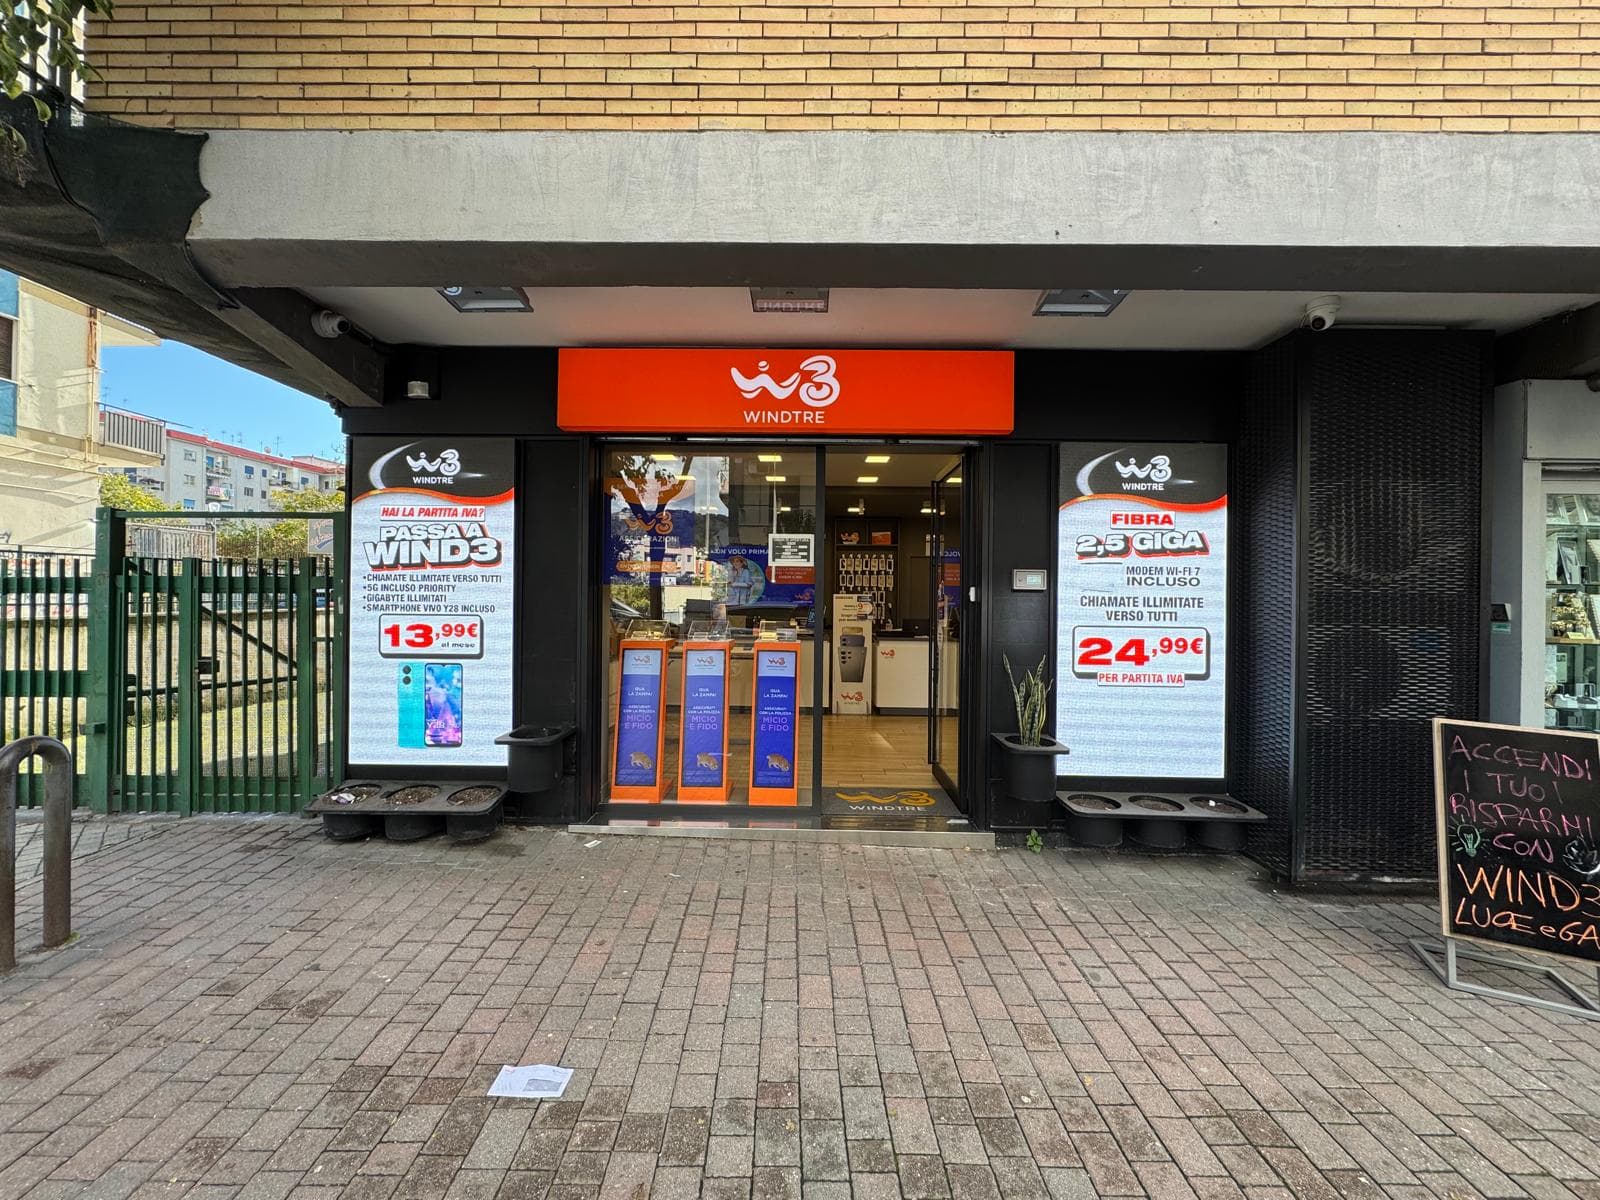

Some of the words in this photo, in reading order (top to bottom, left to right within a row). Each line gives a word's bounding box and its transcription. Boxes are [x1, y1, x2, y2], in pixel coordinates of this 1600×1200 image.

[743, 411, 825, 424] WINDTRE
[412, 476, 454, 485] WINDTRE
[1121, 483, 1165, 491] WINDTRE
[381, 507, 399, 517] HAI
[402, 507, 415, 517] LA
[418, 508, 458, 518] PARTITA
[461, 508, 485, 518] IVA?
[1111, 513, 1174, 526] FIBRA
[380, 523, 462, 541] PASSA
[464, 522, 487, 538] A
[1076, 534, 1128, 558] 2,5
[1132, 530, 1208, 557] GIGA
[363, 537, 502, 570] WIND3
[1126, 566, 1164, 575] MODEM
[1166, 567, 1192, 575] WI-FI
[1194, 567, 1201, 576] 7
[366, 574, 406, 582] CHIAMATE
[409, 574, 451, 582] ILLIMITATE
[453, 575, 479, 583] VERSO
[481, 575, 502, 583] TUTTI
[1126, 577, 1201, 587] INCLUSO
[367, 584, 379, 592] 5G
[381, 584, 416, 592] INCLUSO
[418, 584, 457, 592] PRIORITY
[366, 594, 405, 602] GIGABYTE
[407, 594, 447, 602] ILLIMITATI
[1080, 595, 1139, 608] CHIAMATE
[1142, 596, 1204, 609] ILLIMITATE
[366, 604, 421, 612] SMARTPHONE
[423, 604, 442, 612] VIVO
[443, 605, 459, 613] Y28
[461, 605, 496, 613] INCLUSO
[1106, 611, 1144, 621] VERSO
[1147, 611, 1178, 622] TUTTI
[384, 623, 478, 648] 13,99€
[1078, 637, 1204, 667] 24,99€
[1098, 673, 1118, 683] PER
[1121, 673, 1164, 683] PARTITA
[1166, 674, 1184, 683] IVA
[626, 714, 651, 722] MICIO
[1450, 735, 1592, 781] ACCENDI
[1492, 833, 1554, 864] CON
[1457, 863, 1600, 919] WIND3
